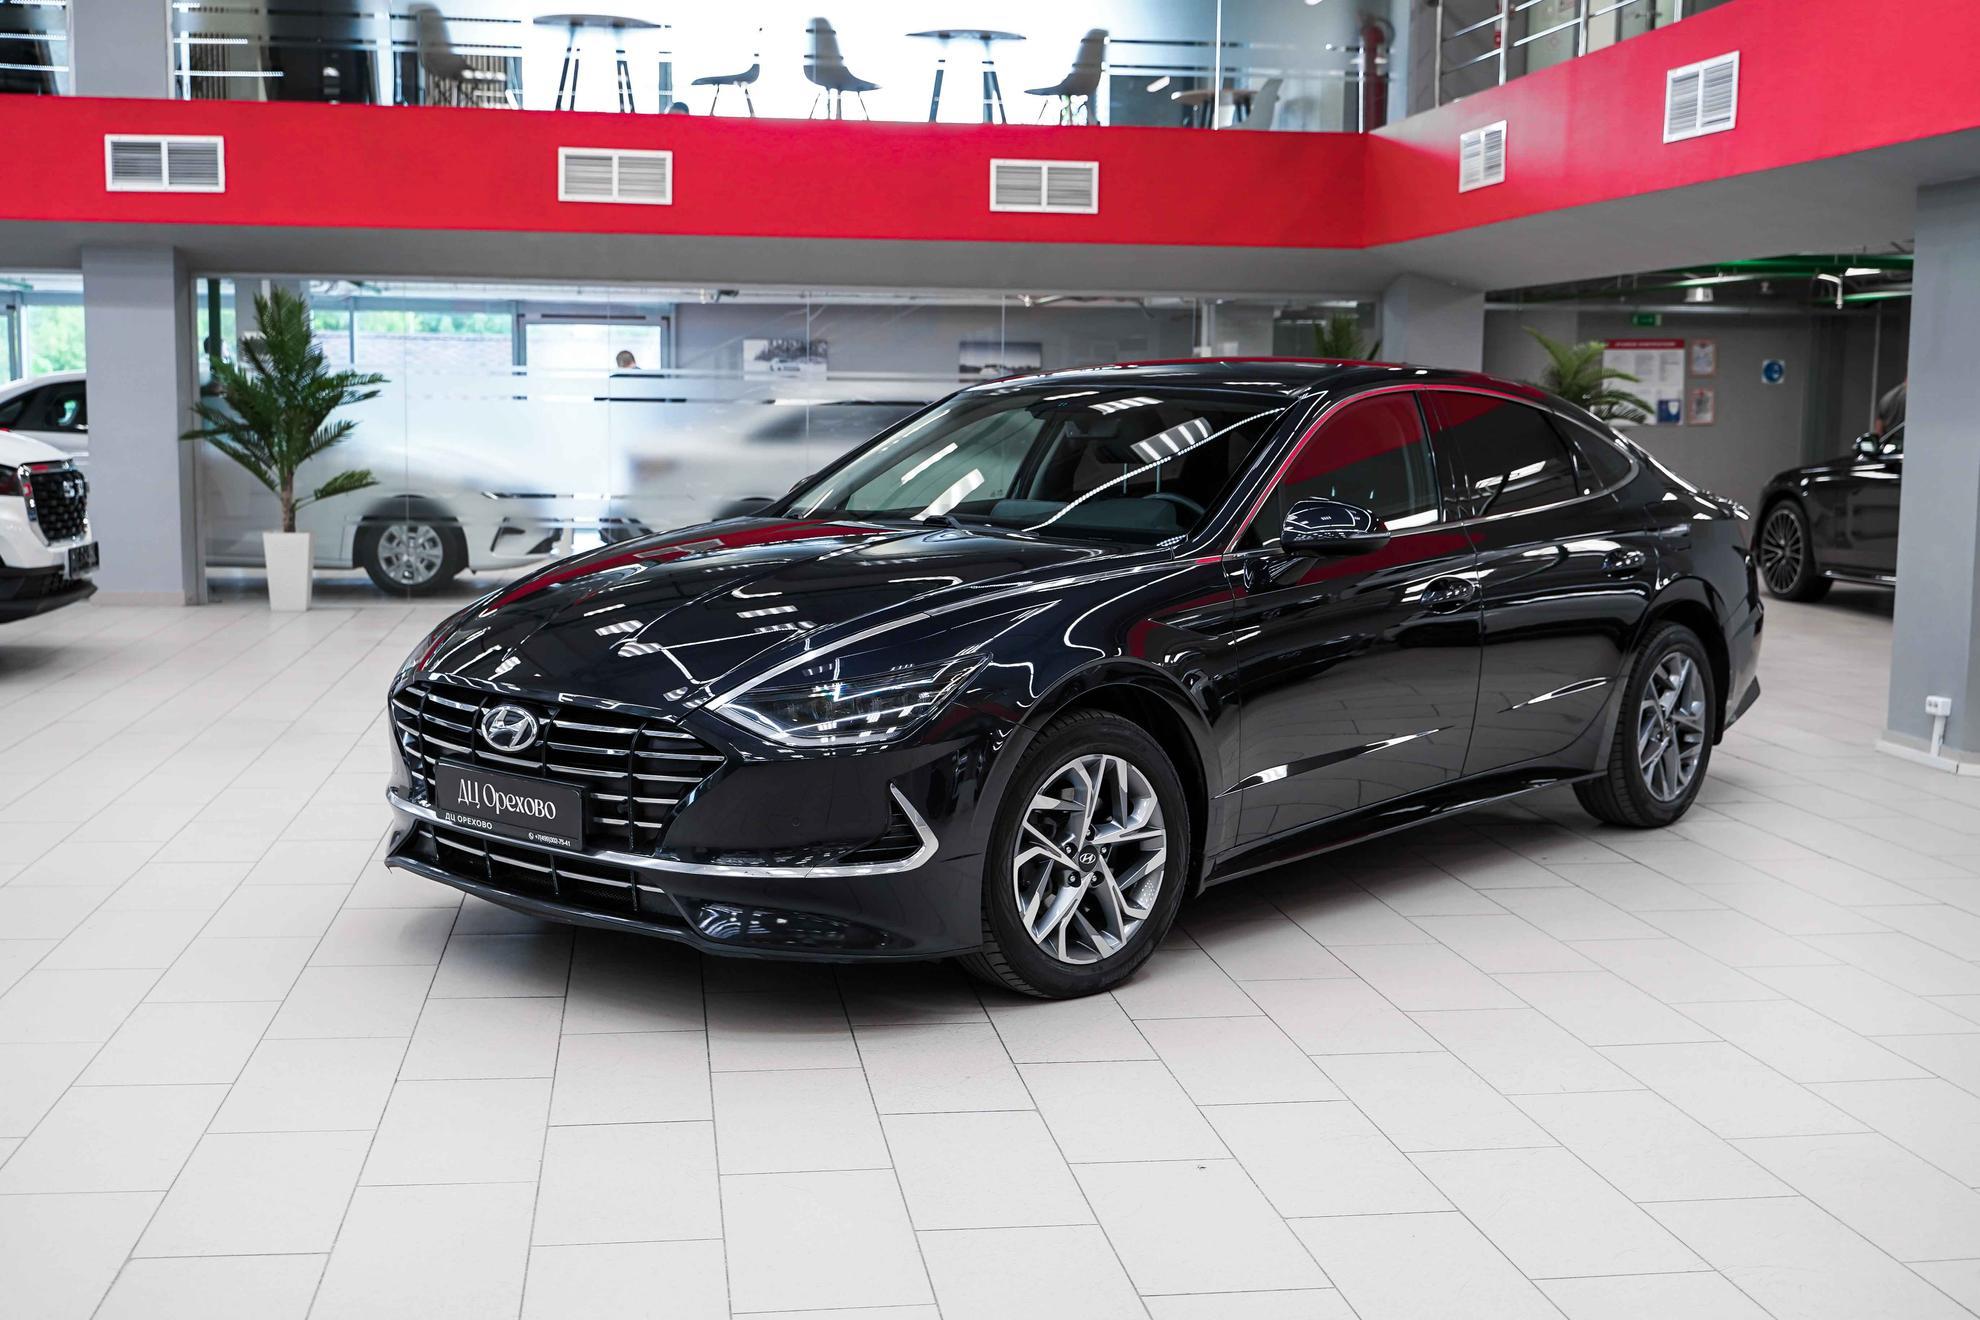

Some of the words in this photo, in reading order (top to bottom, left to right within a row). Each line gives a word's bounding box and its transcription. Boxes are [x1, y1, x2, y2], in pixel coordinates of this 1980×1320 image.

[457, 778, 480, 809] ДЦ
[482, 783, 557, 820] Орехово
[445, 812, 456, 822] ДЦ
[457, 815, 493, 830] ОРЕХОВО
